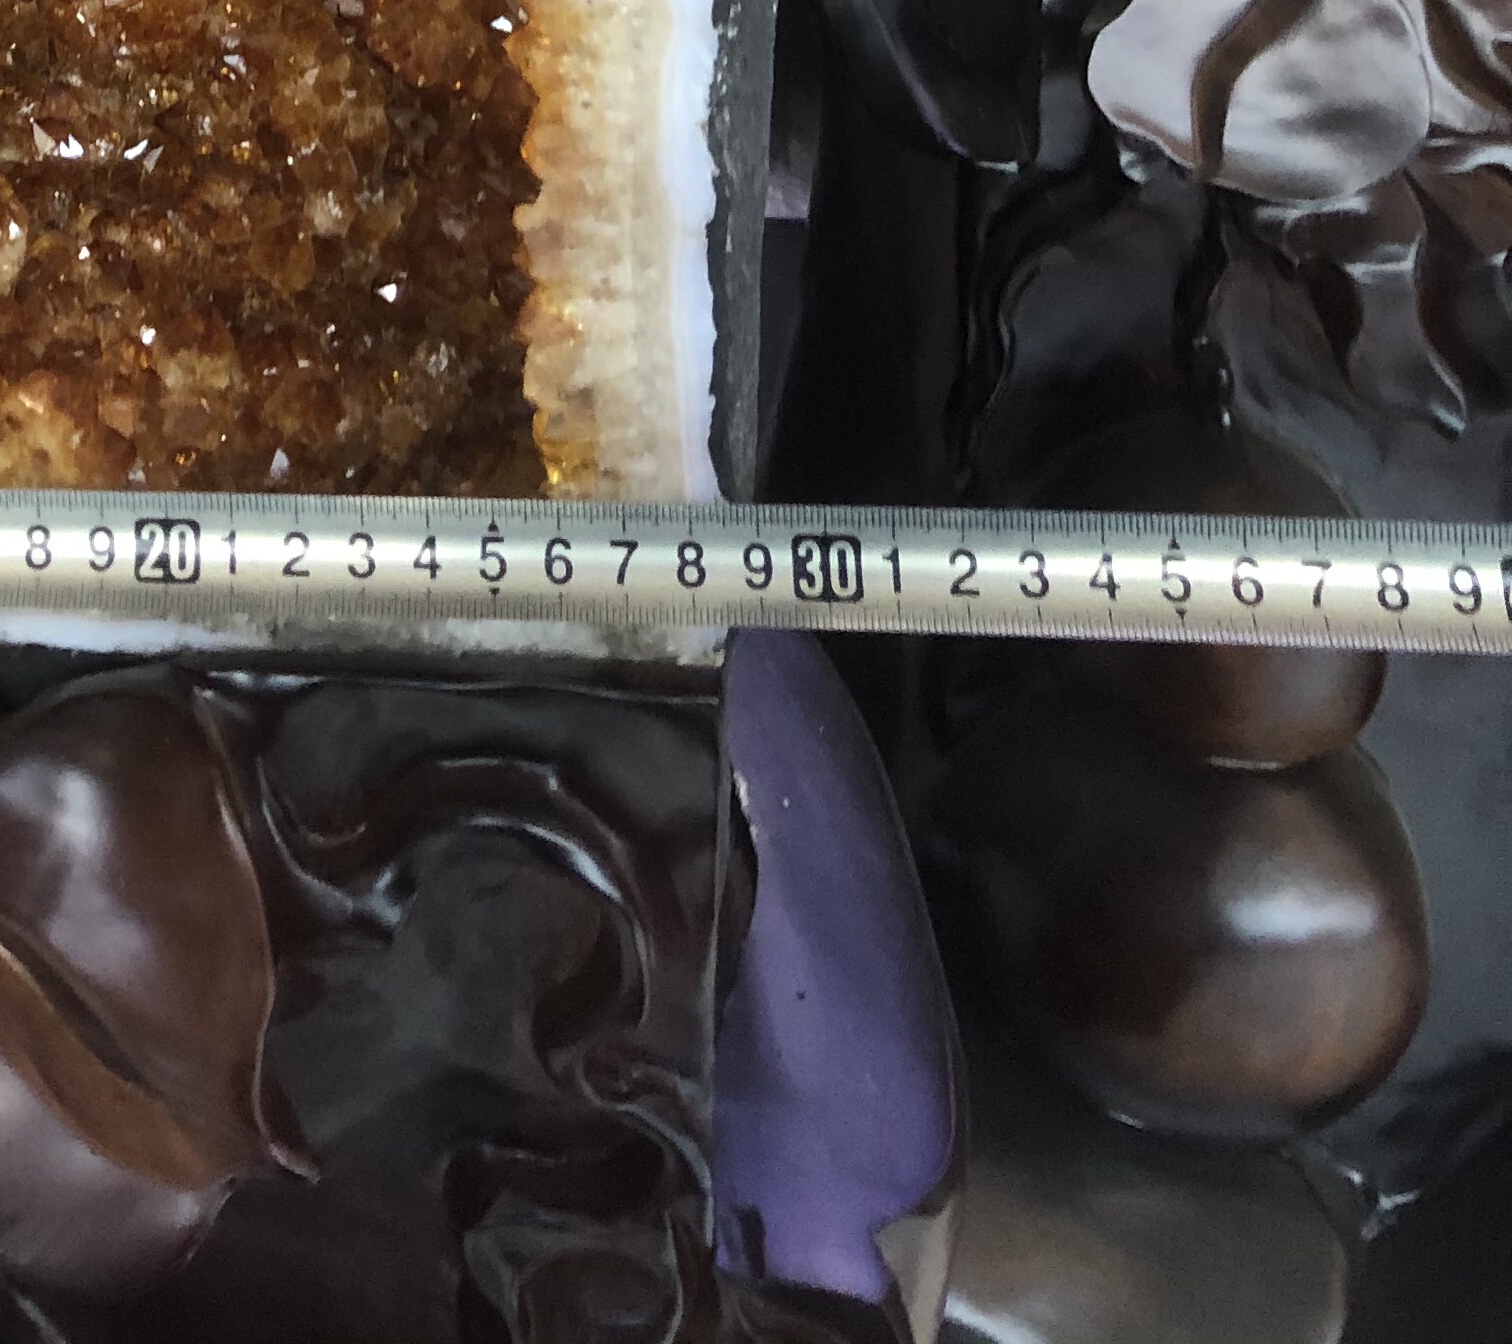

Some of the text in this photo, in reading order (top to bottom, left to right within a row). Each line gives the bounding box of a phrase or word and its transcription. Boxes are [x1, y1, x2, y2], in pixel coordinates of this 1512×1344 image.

[25, 524, 51, 568] 8
[89, 526, 115, 571] 9
[137, 520, 199, 579] 20
[223, 531, 238, 574] 1
[283, 533, 310, 576] 2
[347, 534, 374, 578] 3
[413, 535, 441, 578] 4
[478, 536, 507, 583] 5
[544, 538, 574, 586] 6
[609, 538, 639, 586] 7
[676, 540, 707, 589] 8
[742, 542, 774, 591] 9
[796, 538, 859, 596] 30
[882, 546, 902, 594] 1
[948, 548, 981, 598] 2
[1019, 550, 1050, 601] 3
[1088, 551, 1121, 603] 4
[1161, 555, 1192, 605] 5
[1231, 557, 1264, 608] 6
[1304, 560, 1334, 608] 7
[1377, 560, 1410, 614] 8
[1449, 562, 1483, 617] 9
